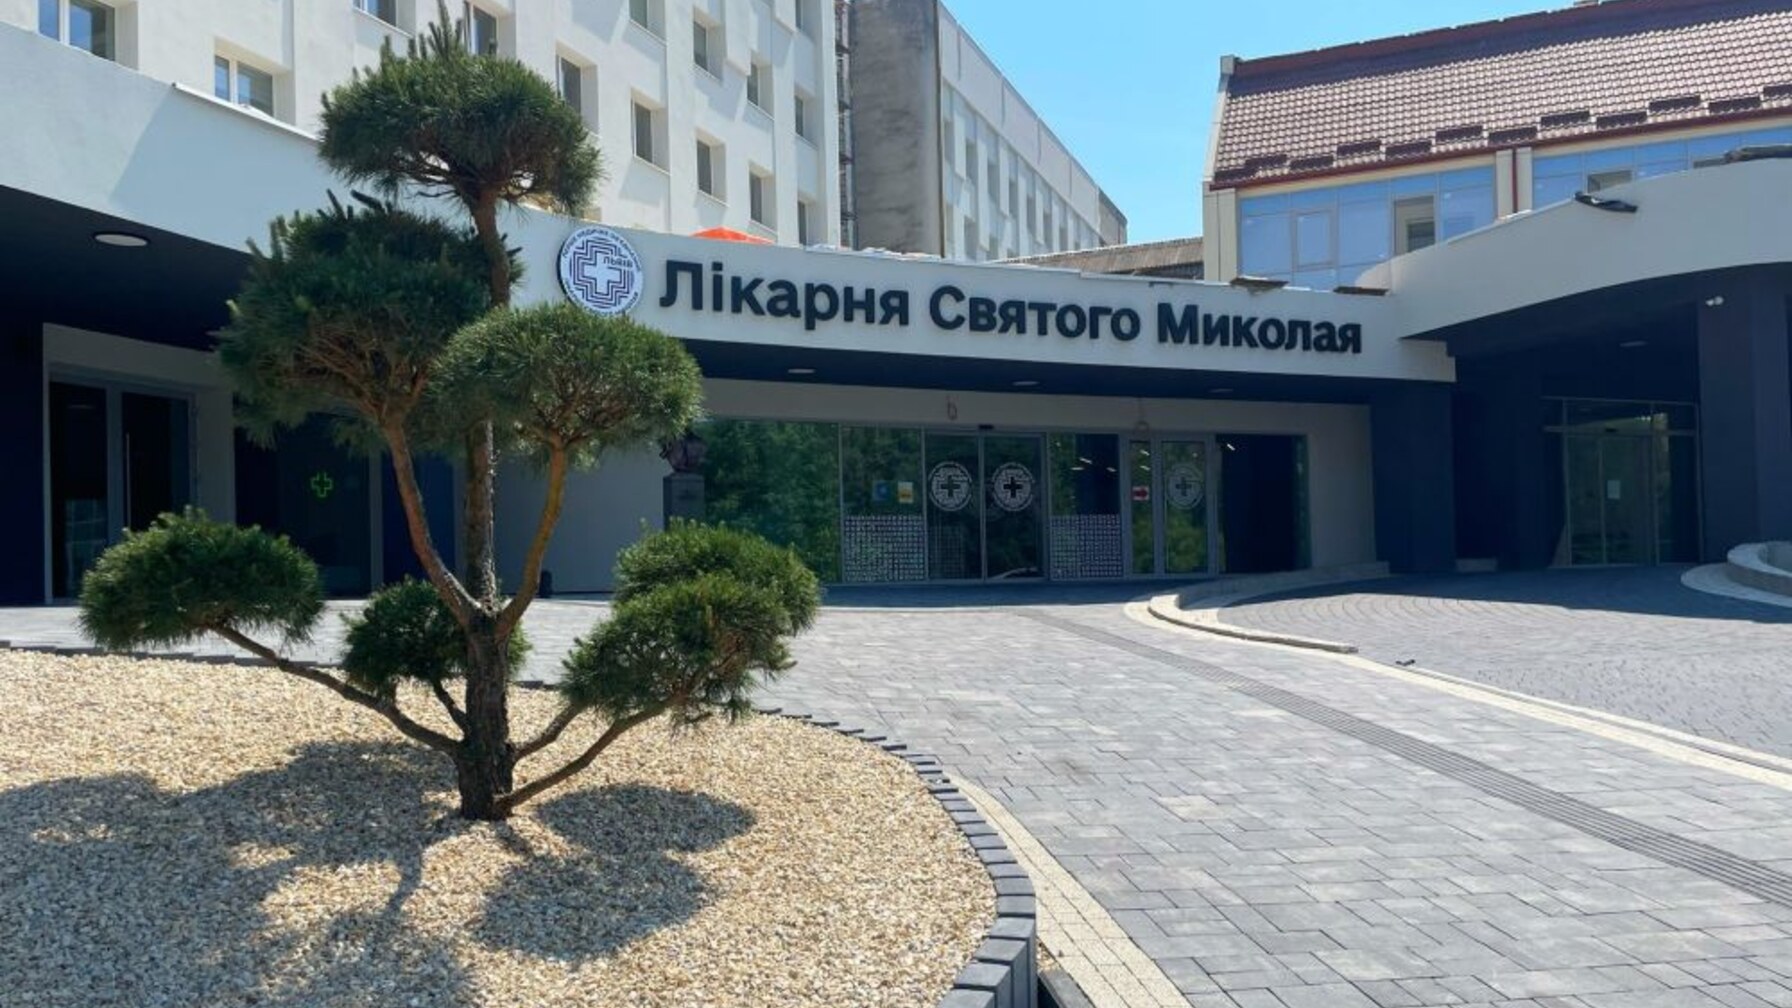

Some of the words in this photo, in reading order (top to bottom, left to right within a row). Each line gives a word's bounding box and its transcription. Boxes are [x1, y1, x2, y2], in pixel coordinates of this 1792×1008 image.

[659, 259, 910, 332] Лікарня
[929, 284, 1142, 342] Святого
[1157, 302, 1364, 355] Миколая
